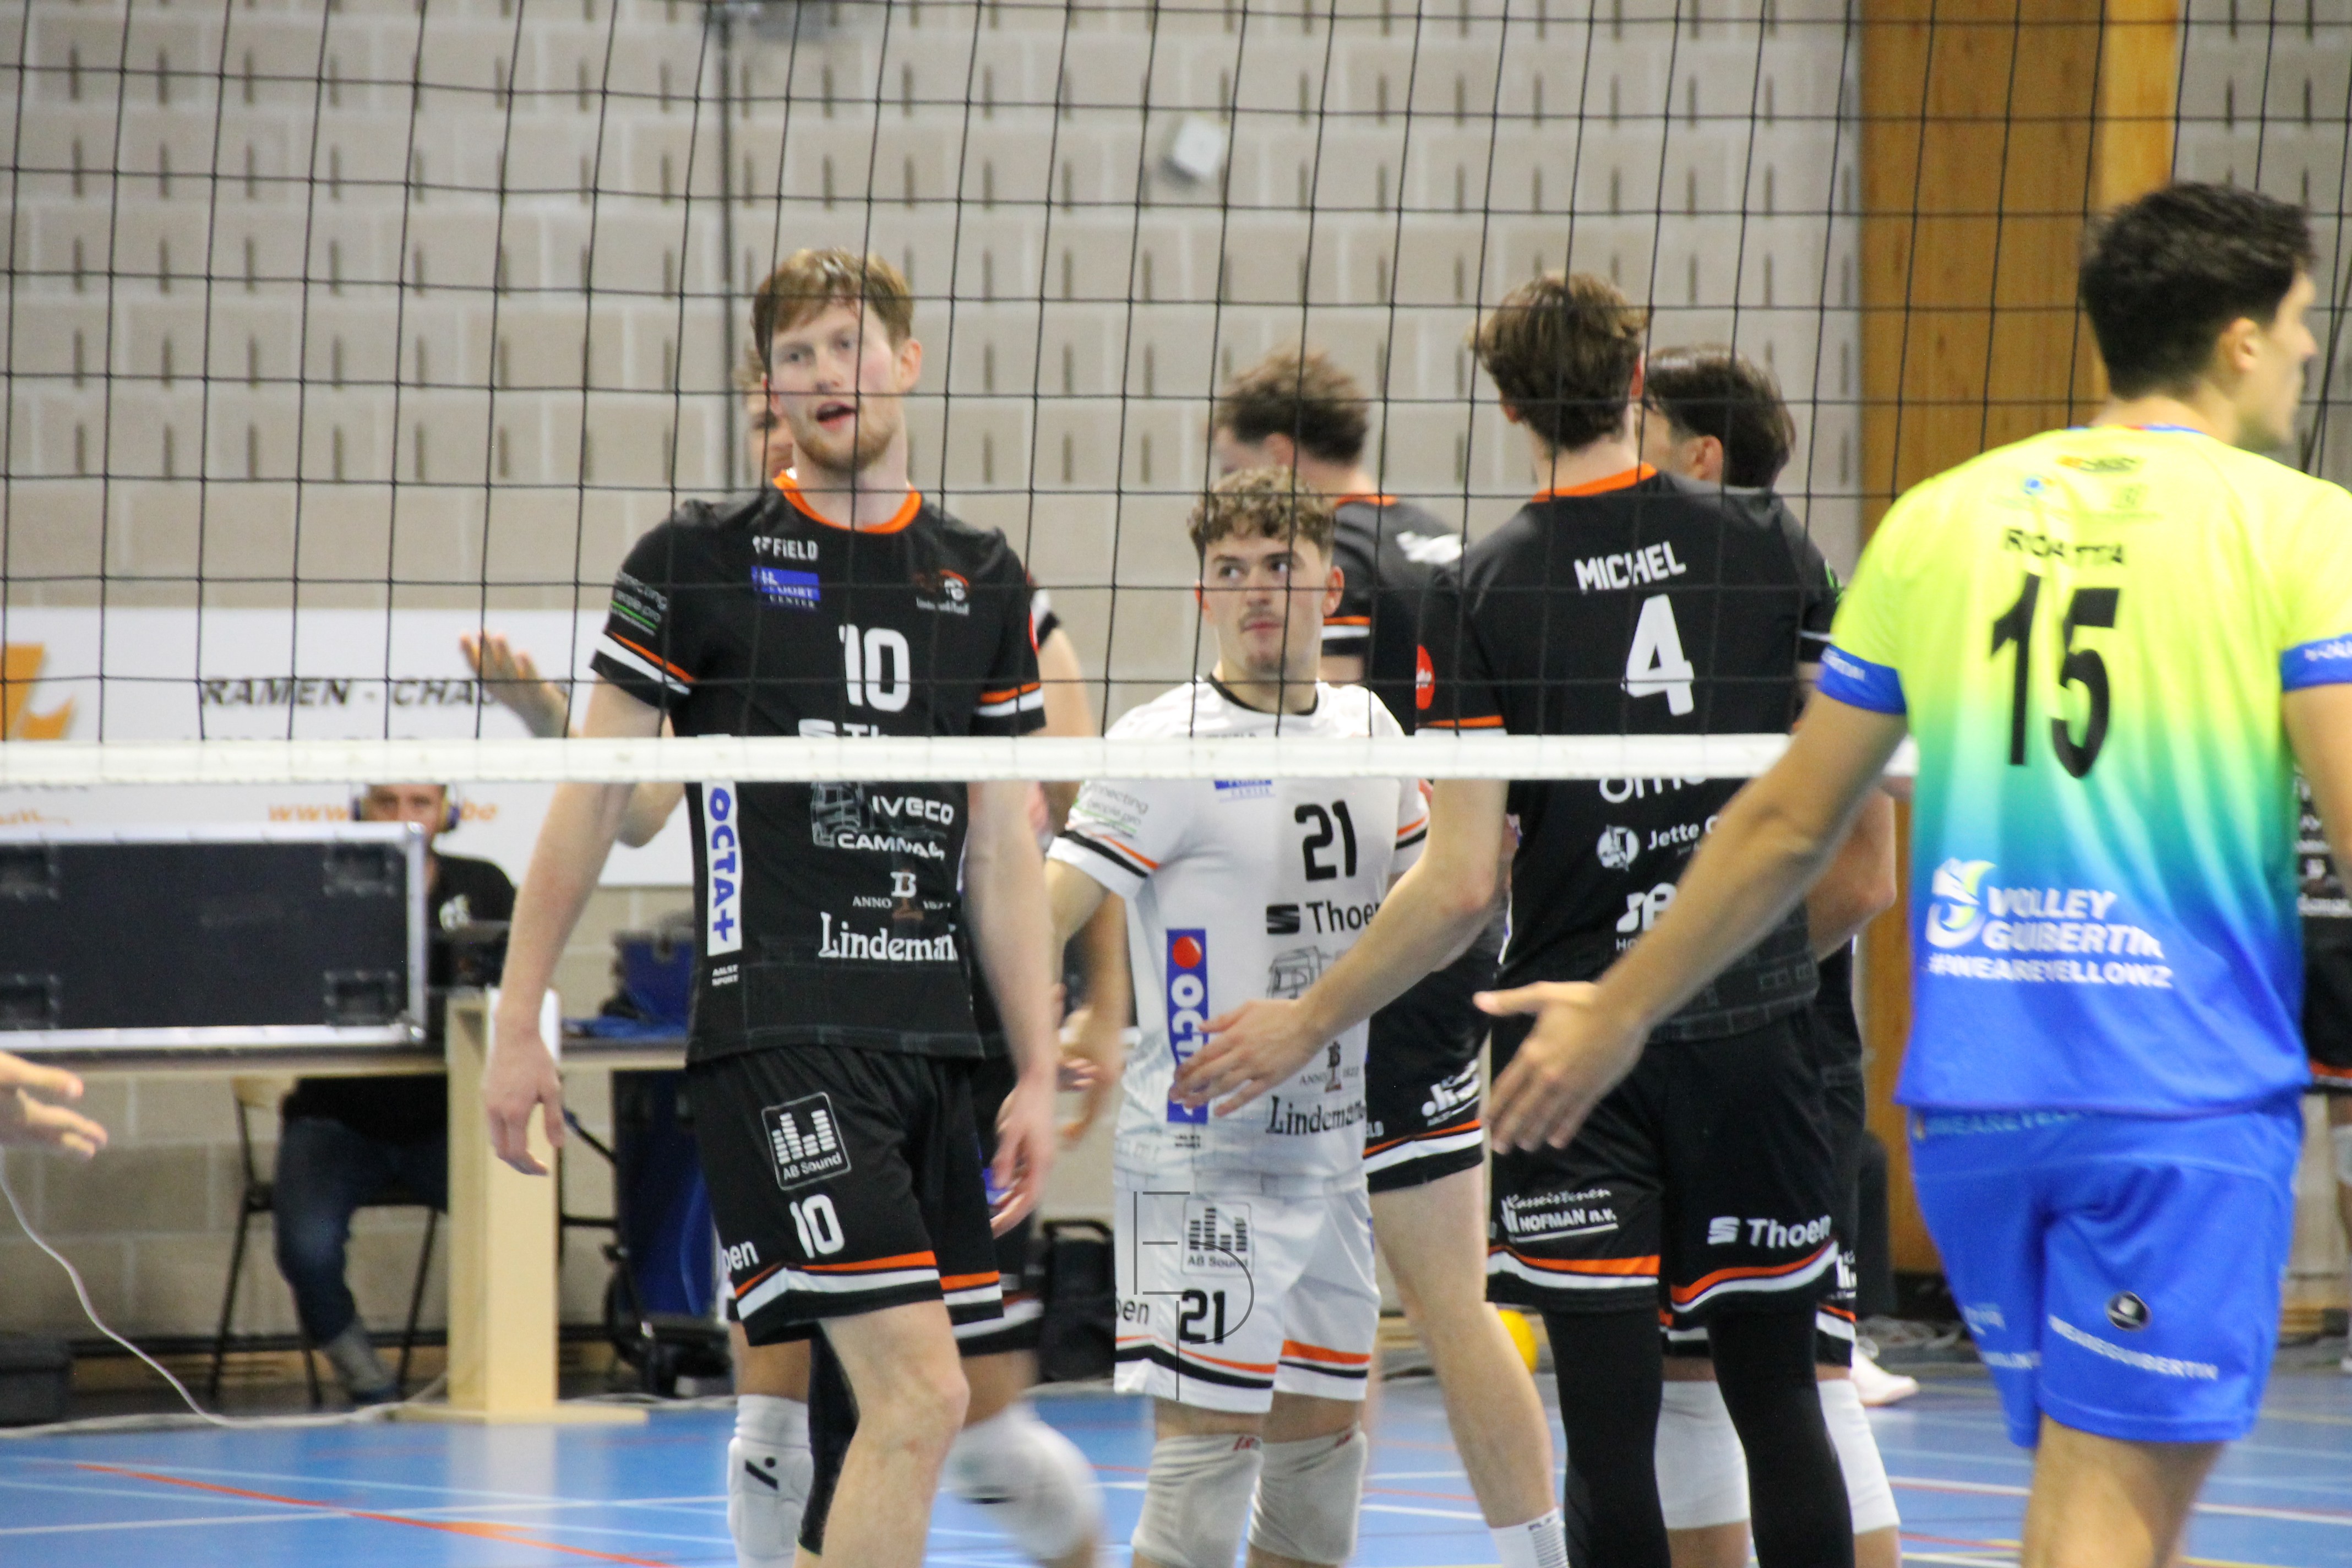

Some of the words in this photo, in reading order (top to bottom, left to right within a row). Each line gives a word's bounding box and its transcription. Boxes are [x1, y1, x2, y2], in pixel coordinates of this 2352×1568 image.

[1574, 541, 1686, 595] MICHEL
[839, 623, 911, 712] 10
[1621, 594, 1695, 716] 4
[1990, 573, 2121, 779] 15
[203, 678, 352, 706] RAMEN
[872, 794, 954, 825] IVECO
[1294, 799, 1357, 882] 21
[1648, 823, 1700, 851] Jette
[709, 787, 736, 942] OCTA+
[852, 896, 893, 908] ANNO
[1987, 886, 2117, 920] VOLLEY
[783, 1163, 801, 1180] AB
[801, 1151, 843, 1174] Sound
[790, 1194, 845, 1259] 10
[1518, 1208, 1586, 1232] HOFMAN
[1746, 1214, 1831, 1249] Thoen
[1179, 1289, 1226, 1344] 21
